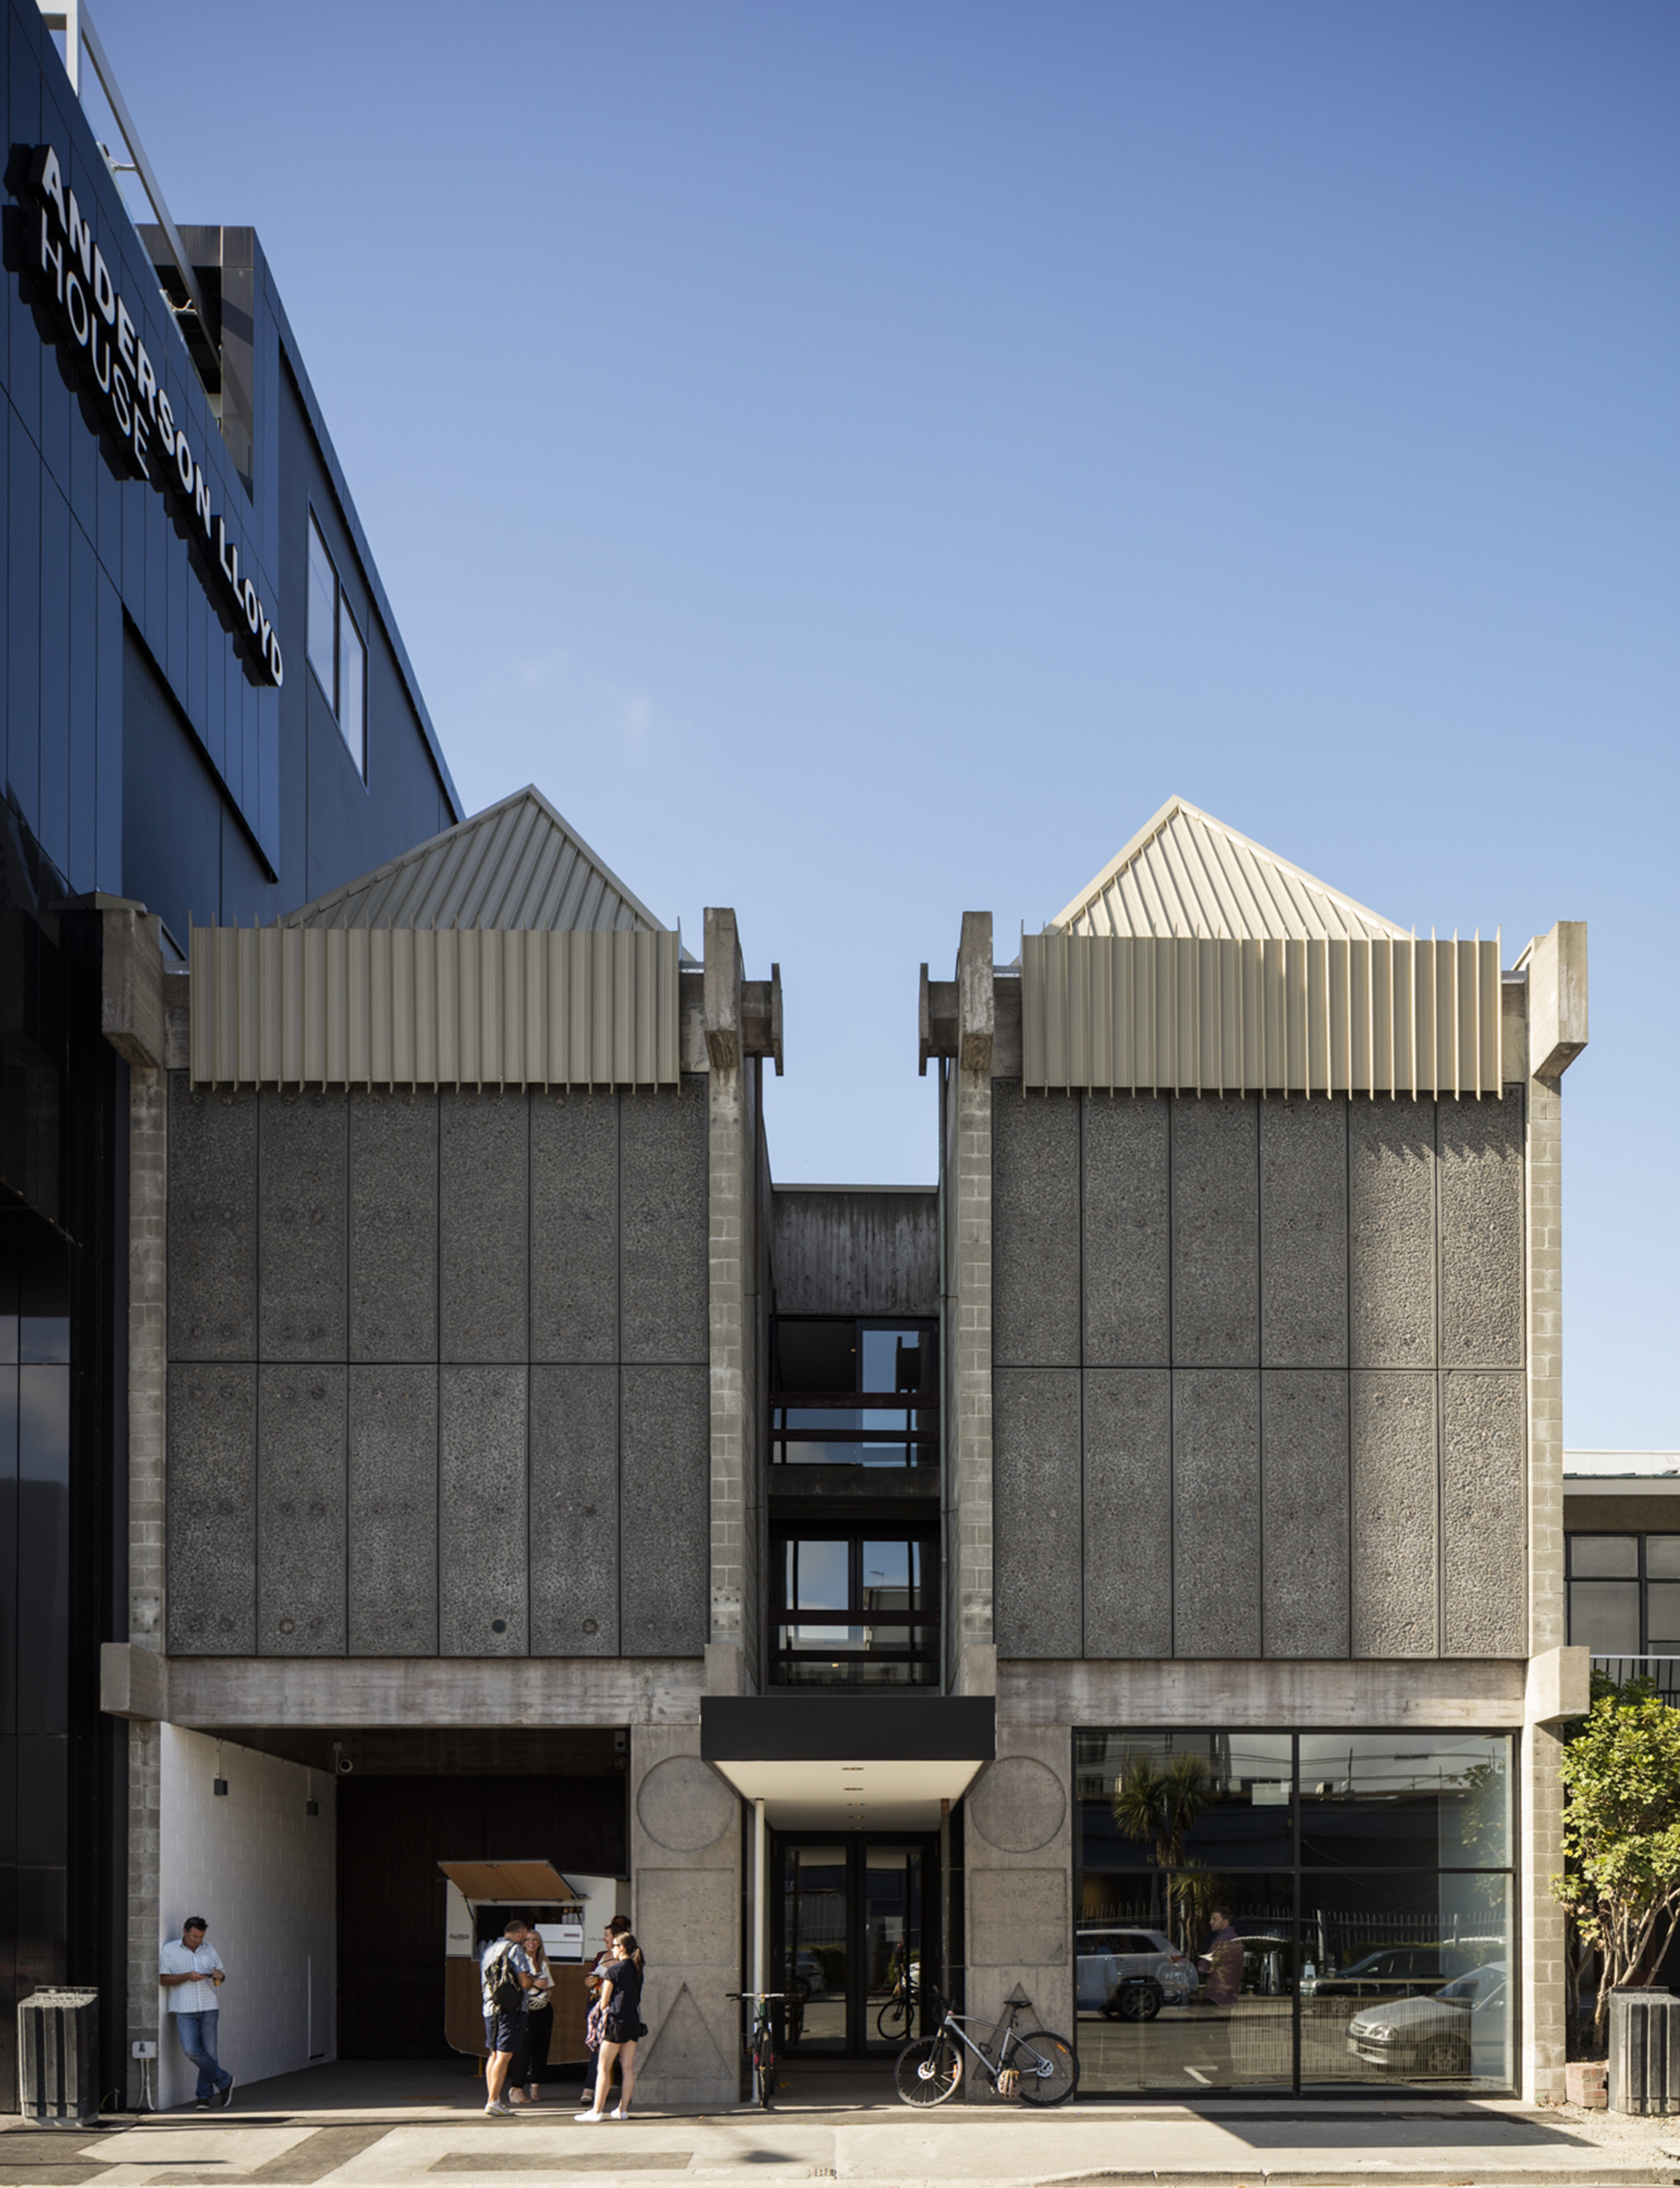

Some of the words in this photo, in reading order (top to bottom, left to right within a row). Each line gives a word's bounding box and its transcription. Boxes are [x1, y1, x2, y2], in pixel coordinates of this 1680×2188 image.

[41, 207, 150, 480] HOUSE
[42, 145, 211, 539] ANDERSON
[220, 516, 284, 688] LLOYD
